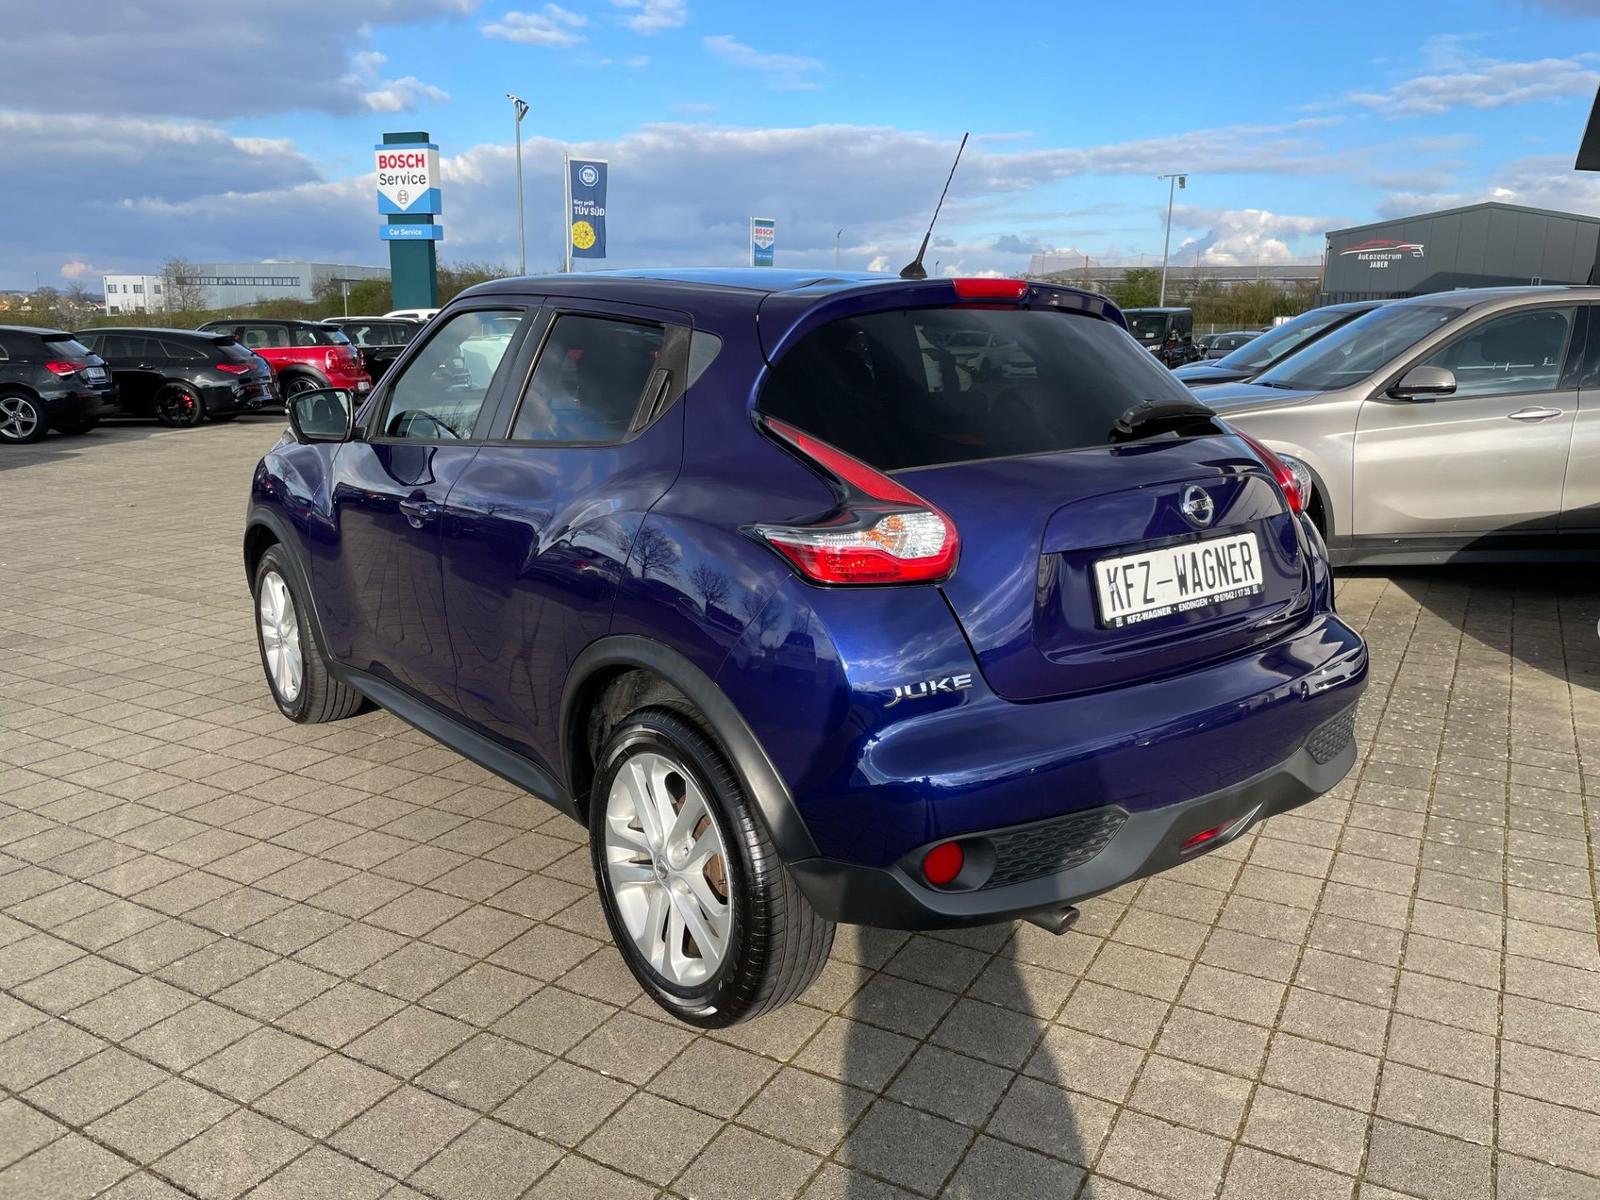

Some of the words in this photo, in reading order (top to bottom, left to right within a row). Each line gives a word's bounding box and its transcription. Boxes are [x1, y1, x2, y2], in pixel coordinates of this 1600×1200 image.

[379, 154, 425, 169] BOSCH
[379, 172, 427, 186] Service
[574, 206, 589, 215] TÜV
[590, 206, 605, 217] SÜD
[389, 228, 399, 236] Car
[401, 228, 422, 236] Service
[1106, 541, 1255, 612] KFZ-WAGNER
[1127, 606, 1172, 624] KFZ-WAGNER
[1178, 598, 1208, 612] ENDINGEN
[884, 673, 973, 708] JUKE
